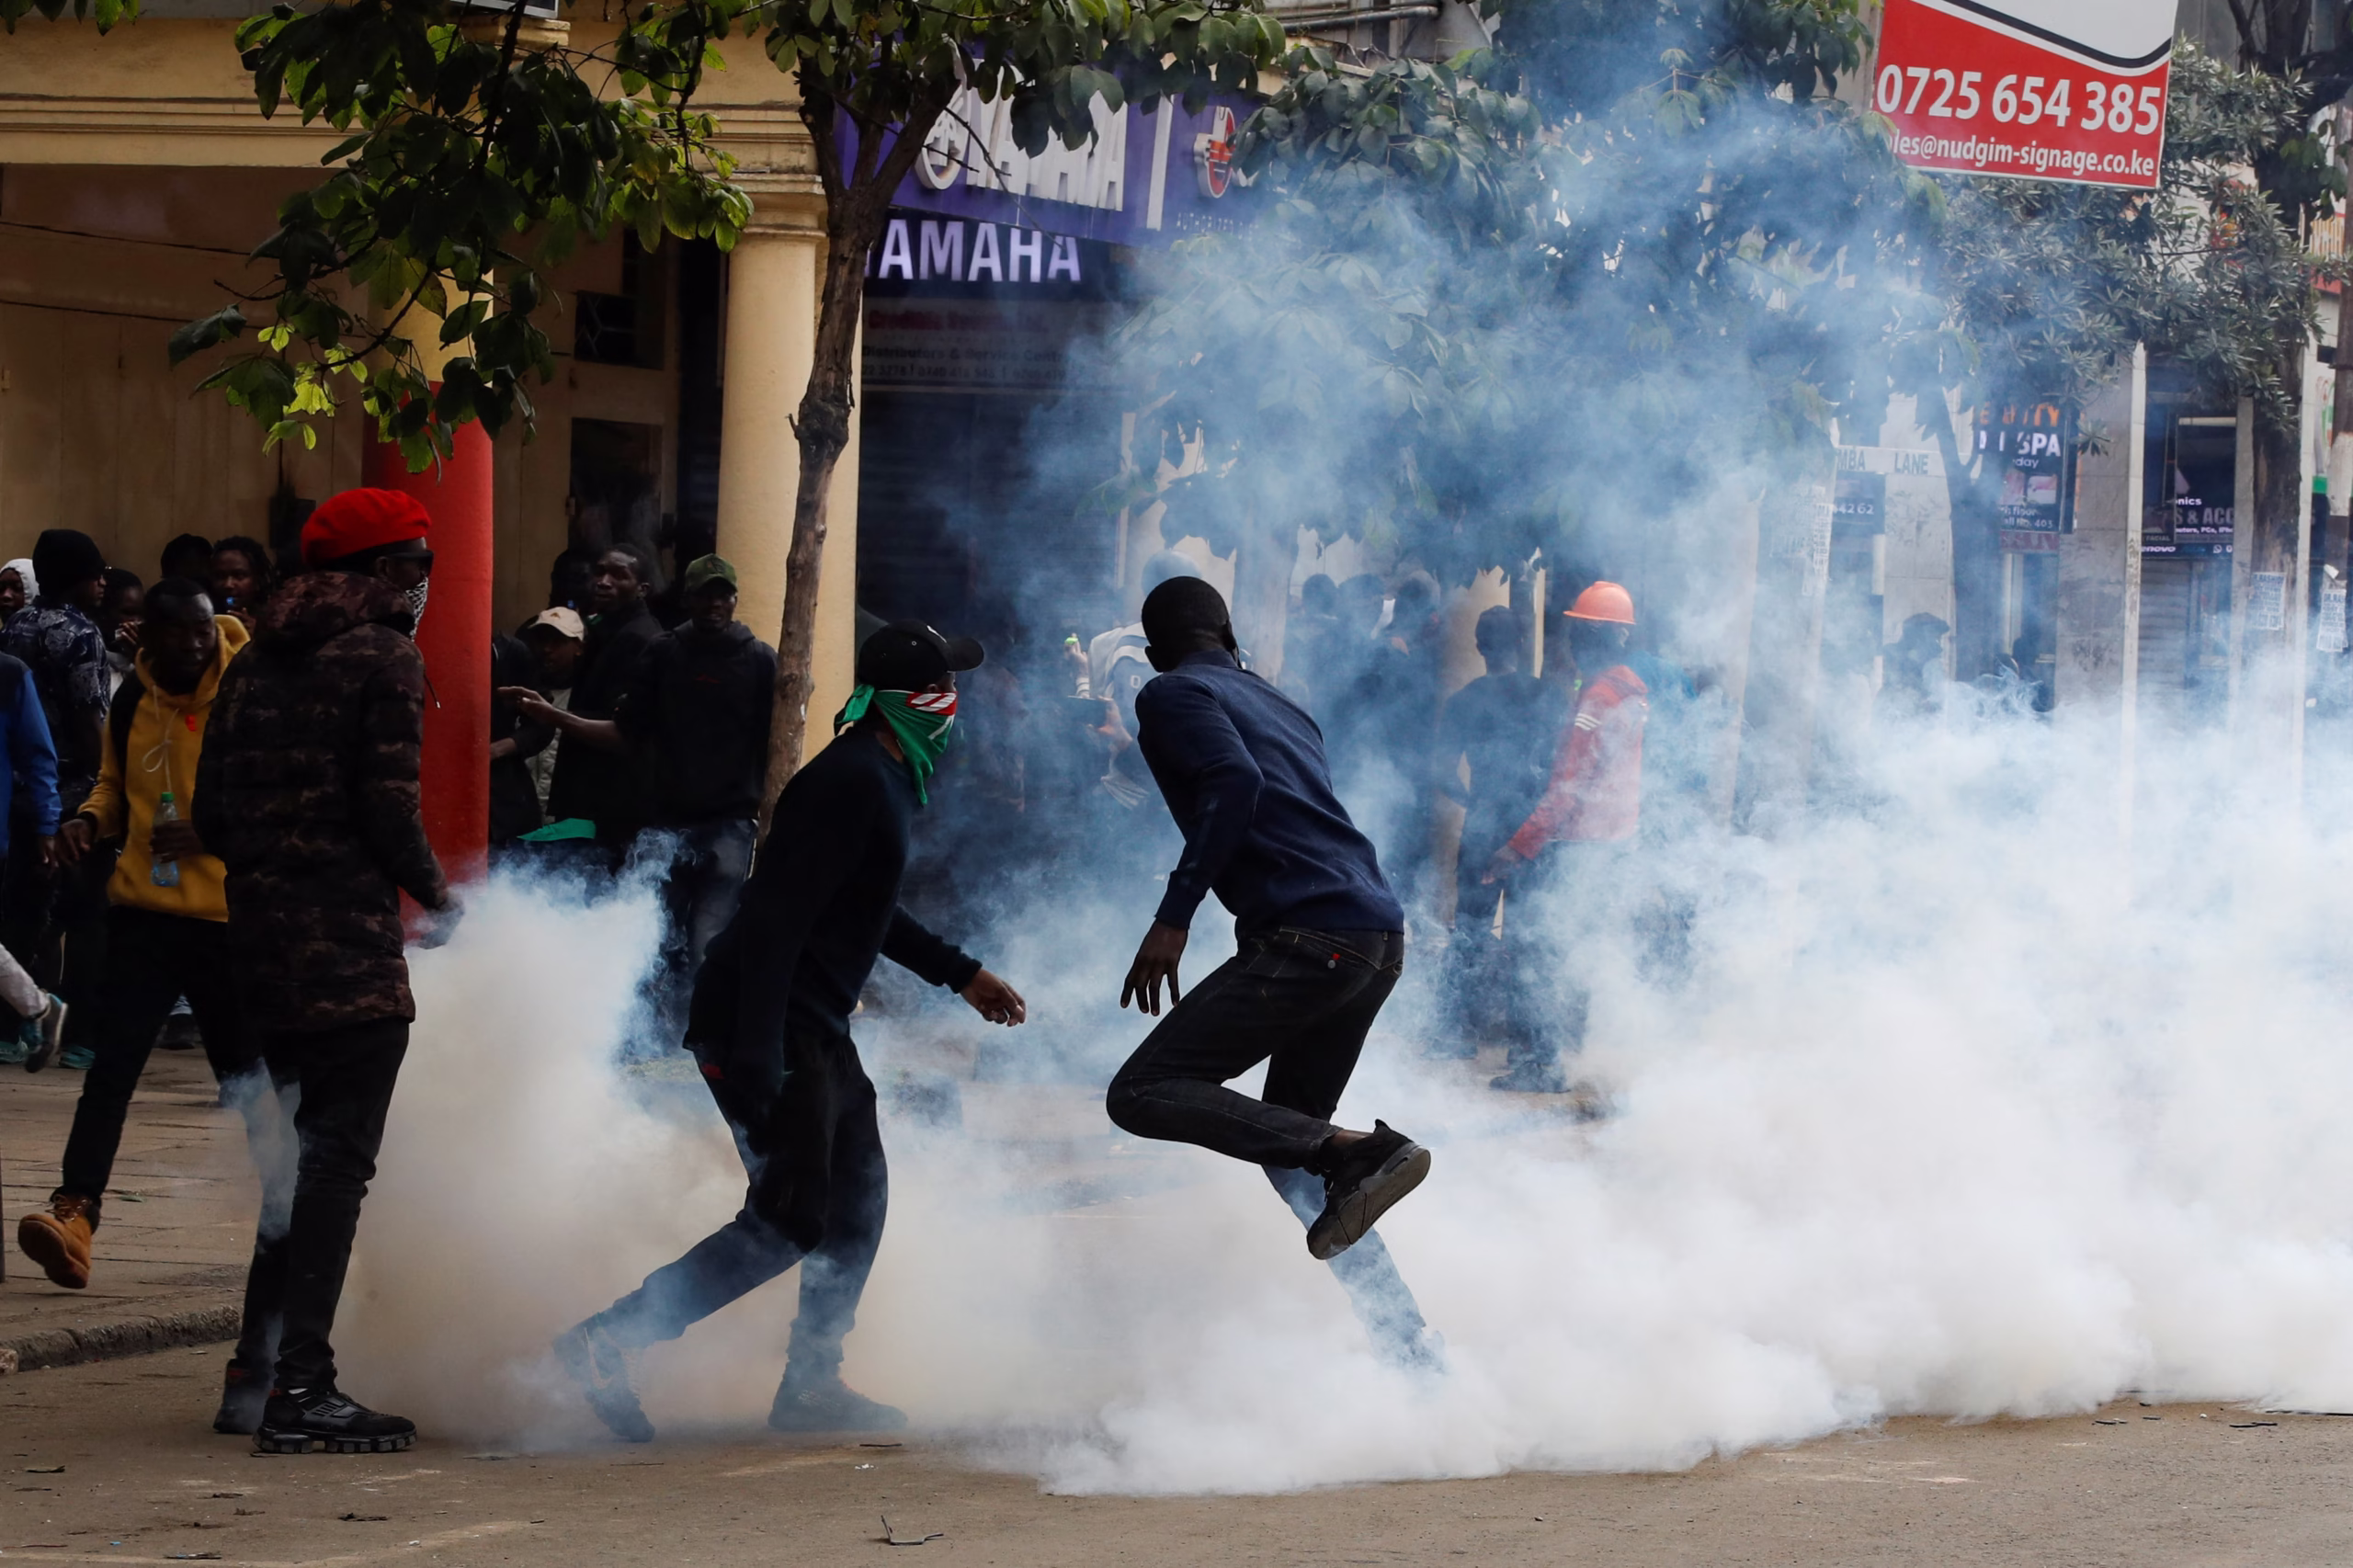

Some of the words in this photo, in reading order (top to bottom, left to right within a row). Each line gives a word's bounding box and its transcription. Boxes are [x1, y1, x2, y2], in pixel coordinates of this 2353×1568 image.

[1877, 64, 1982, 119] 0725
[1992, 74, 2071, 128] 654
[2080, 81, 2162, 136] 385
[1889, 129, 2155, 177] les@nudgim-signage.co.ke
[865, 218, 1081, 283] AMAHA
[2017, 430, 2062, 457] SPA
[1837, 448, 1867, 471] MBA
[1894, 452, 1929, 475] LANE
[2014, 457, 2040, 469] day
[2141, 544, 2177, 553] enovo
